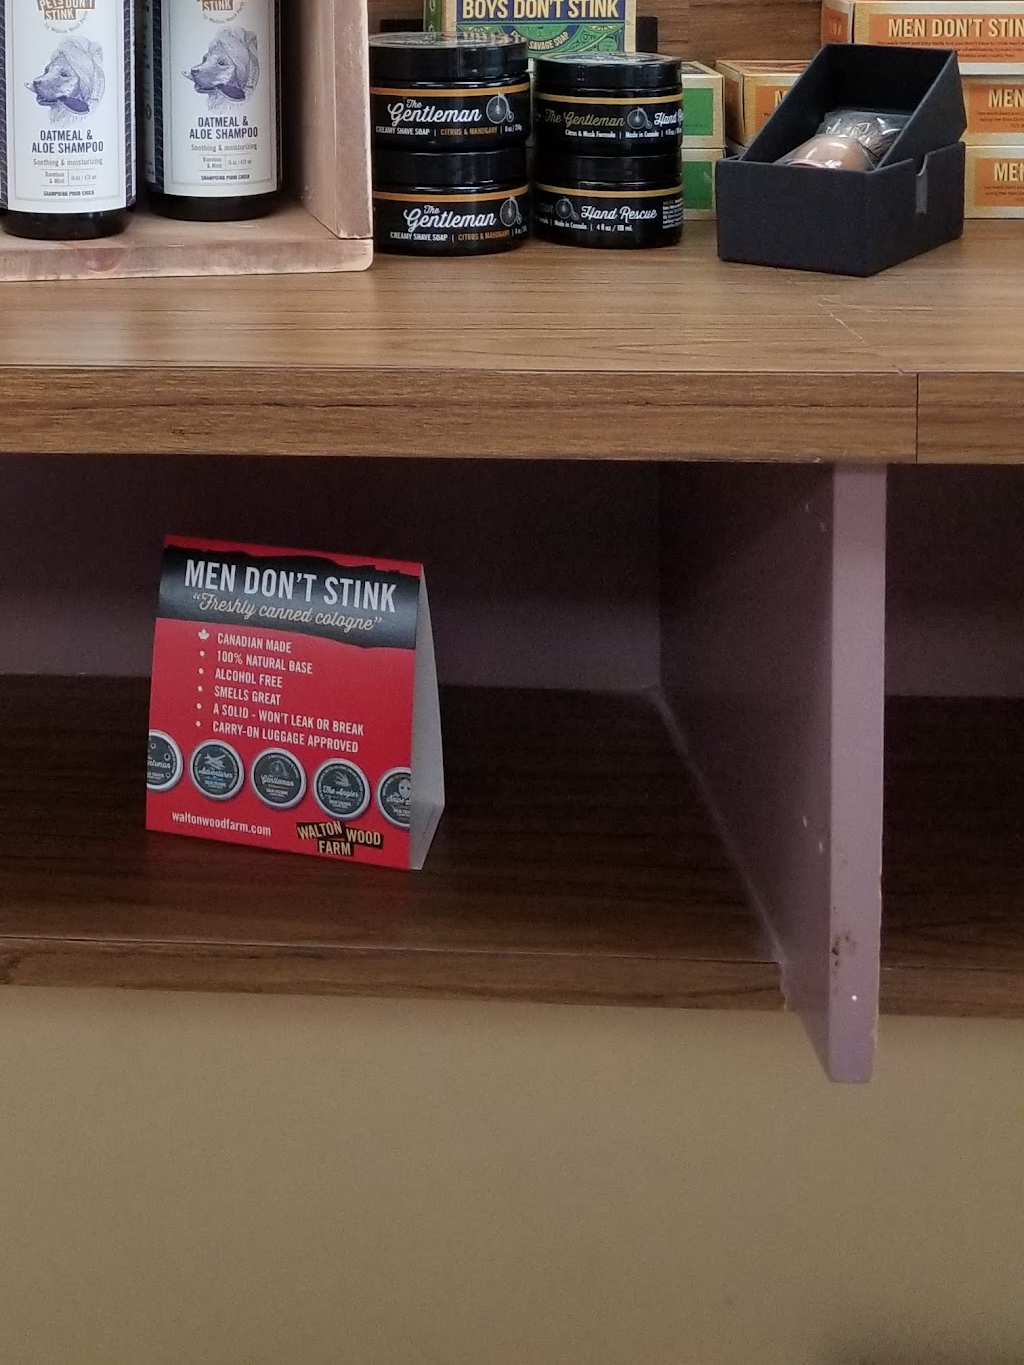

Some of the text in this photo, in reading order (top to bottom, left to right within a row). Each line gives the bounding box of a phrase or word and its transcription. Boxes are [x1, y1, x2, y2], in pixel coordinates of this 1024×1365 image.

[44, 8, 76, 21] STINK
[202, 0, 233, 11] STINK
[888, 18, 926, 38] MEN
[931, 18, 983, 38] DON'T
[529, 31, 569, 50] SAVAGE SOAP
[406, 99, 422, 108] The
[198, 115, 248, 127] OATMEAL &
[387, 102, 482, 127] Gentleman
[545, 109, 625, 128] The Gentleman
[40, 129, 93, 141] OATMEAL &
[189, 126, 258, 139] ALOE SHAMPOO
[32, 140, 104, 153] ALOE SHAMPOO
[424, 205, 440, 214] The
[581, 205, 618, 220] Hand
[620, 206, 657, 223] Rescue
[403, 208, 497, 232] Gentleman
[184, 559, 397, 613] MEN DON'T STINK
[259, 604, 313, 624] canned
[217, 632, 292, 653] CANADIAN MADE
[216, 650, 313, 675] 100% NATURAL BASE
[214, 668, 283, 688] ALCOHOL FREE
[214, 685, 282, 706] SMELLS GREAT
[213, 703, 364, 736] A SOLID WON'T LEAK OR BREAK
[212, 720, 359, 753] CARRY-ON LUGGAGE APPROVED
[171, 811, 272, 837] waltonwoodfarm.com
[297, 821, 381, 846] WALTON WOOD
[318, 840, 352, 856] FARM
